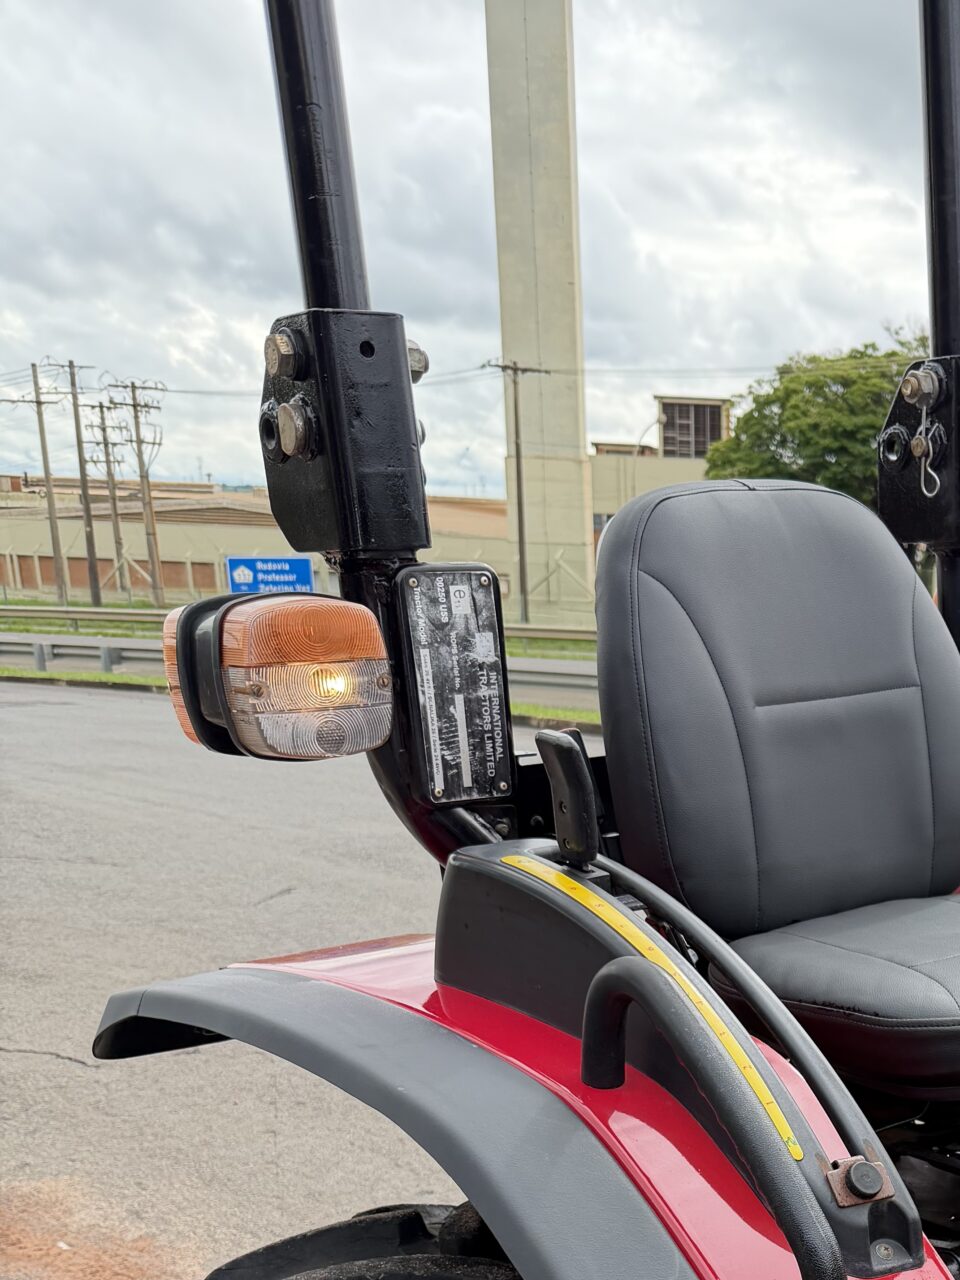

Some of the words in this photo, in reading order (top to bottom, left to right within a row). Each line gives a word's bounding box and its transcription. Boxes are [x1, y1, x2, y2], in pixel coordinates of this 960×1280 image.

[255, 560, 290, 571] Rodovia
[256, 571, 297, 582] Professor
[413, 587, 424, 617] Tractor
[435, 576, 447, 603] 00250
[418, 618, 428, 645] Model
[478, 669, 492, 731] TRACTORS
[489, 672, 504, 761] INTERNATIONAL
[484, 733, 496, 777] LIMITED
